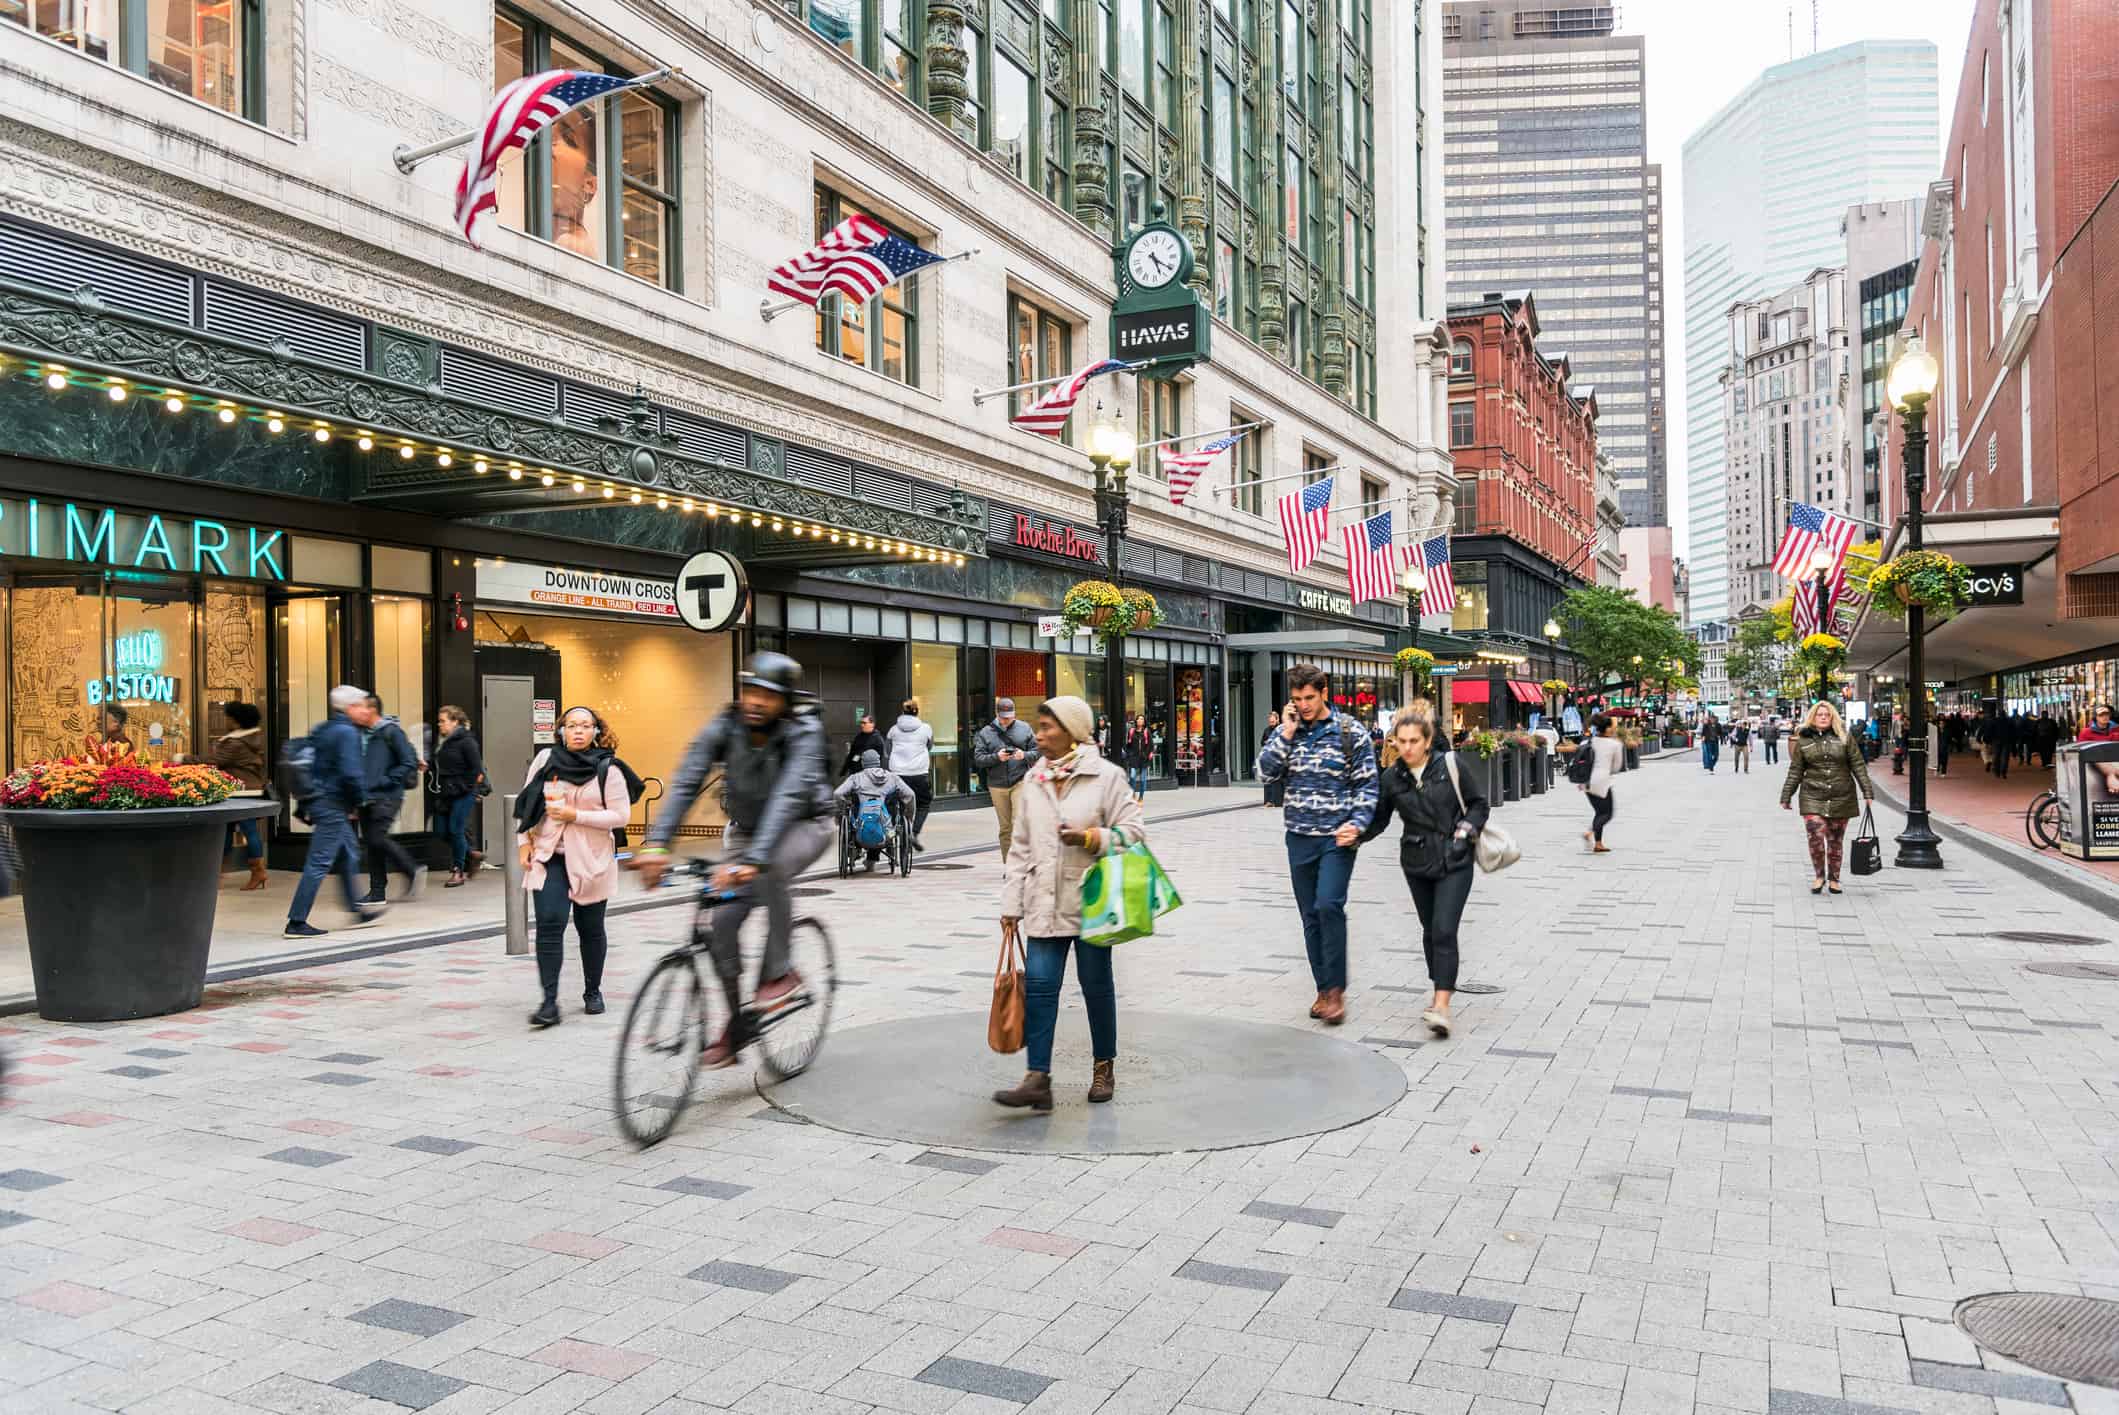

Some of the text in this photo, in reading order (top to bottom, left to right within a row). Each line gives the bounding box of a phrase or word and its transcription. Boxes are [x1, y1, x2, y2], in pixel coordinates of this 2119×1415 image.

[1121, 322, 1190, 347] HAVAS
[0, 497, 285, 581] IMARK
[1015, 513, 1063, 555] Roche
[545, 570, 631, 596] DOWNTOWN
[1958, 572, 2015, 597] acy's
[534, 591, 567, 603] ORANGE
[568, 595, 585, 606] LINE
[592, 598, 604, 608] ALL
[605, 599, 632, 610] TRAINS
[638, 602, 651, 611] RED
[652, 603, 667, 613] LINE
[684, 573, 726, 620] T
[1329, 595, 1351, 615] NERO
[87, 673, 174, 705] BOSTON
